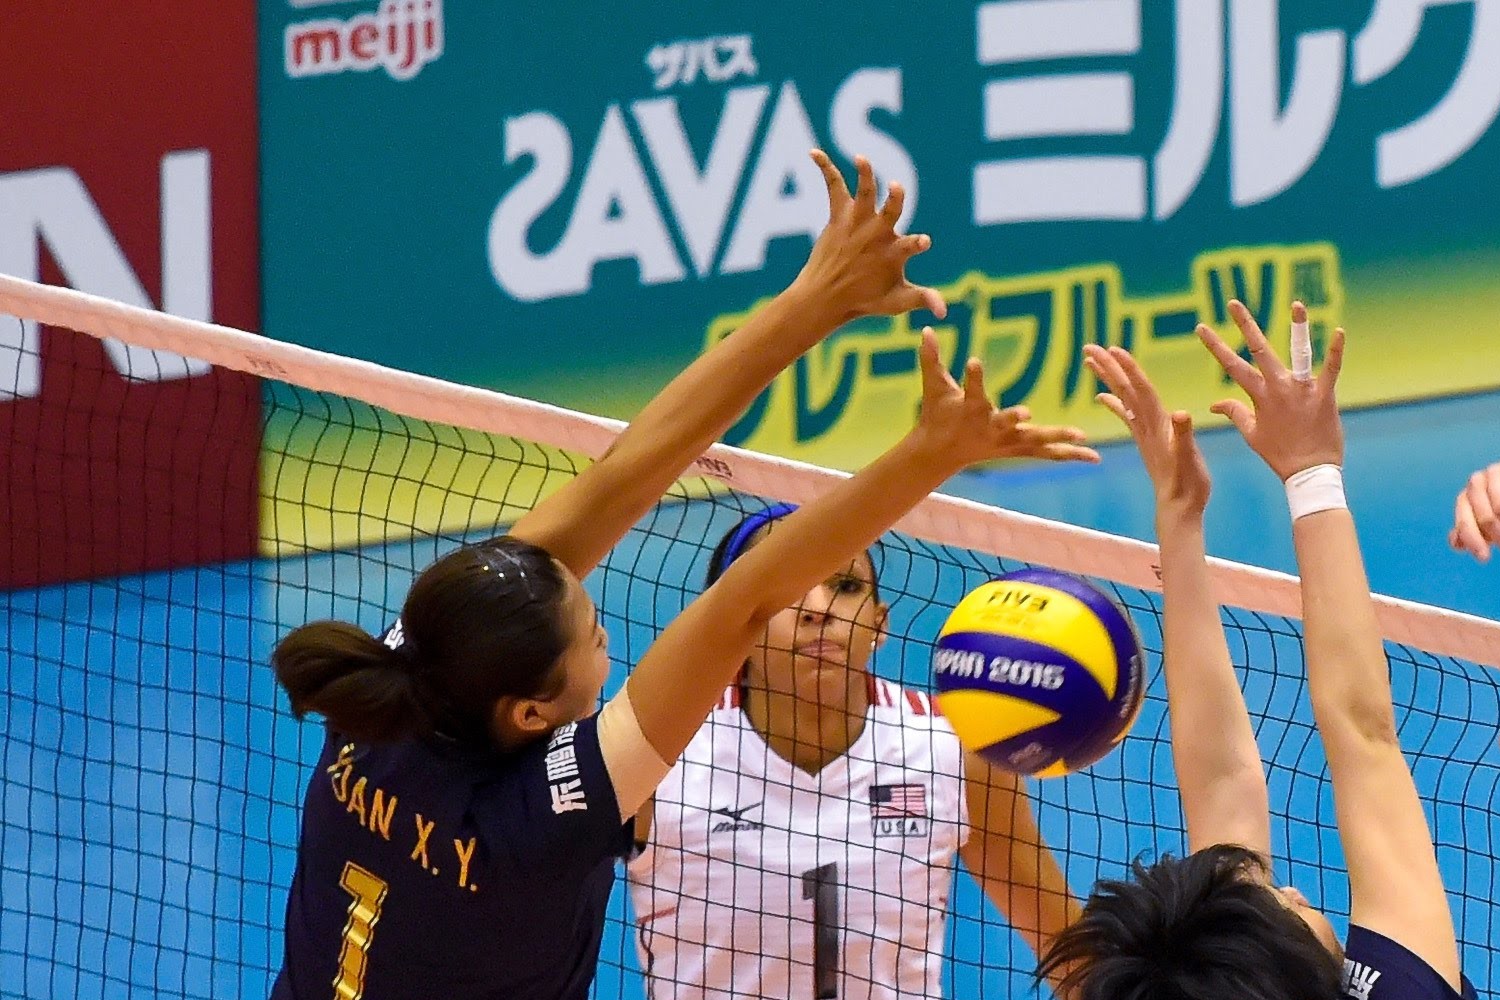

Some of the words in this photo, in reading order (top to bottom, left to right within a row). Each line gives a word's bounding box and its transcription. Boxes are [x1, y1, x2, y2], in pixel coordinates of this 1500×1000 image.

[290, 0, 438, 72] meiji
[488, 67, 920, 301] SAVAS
[934, 647, 985, 679] PAN
[988, 655, 1066, 691] 2015
[802, 860, 839, 1000] 1
